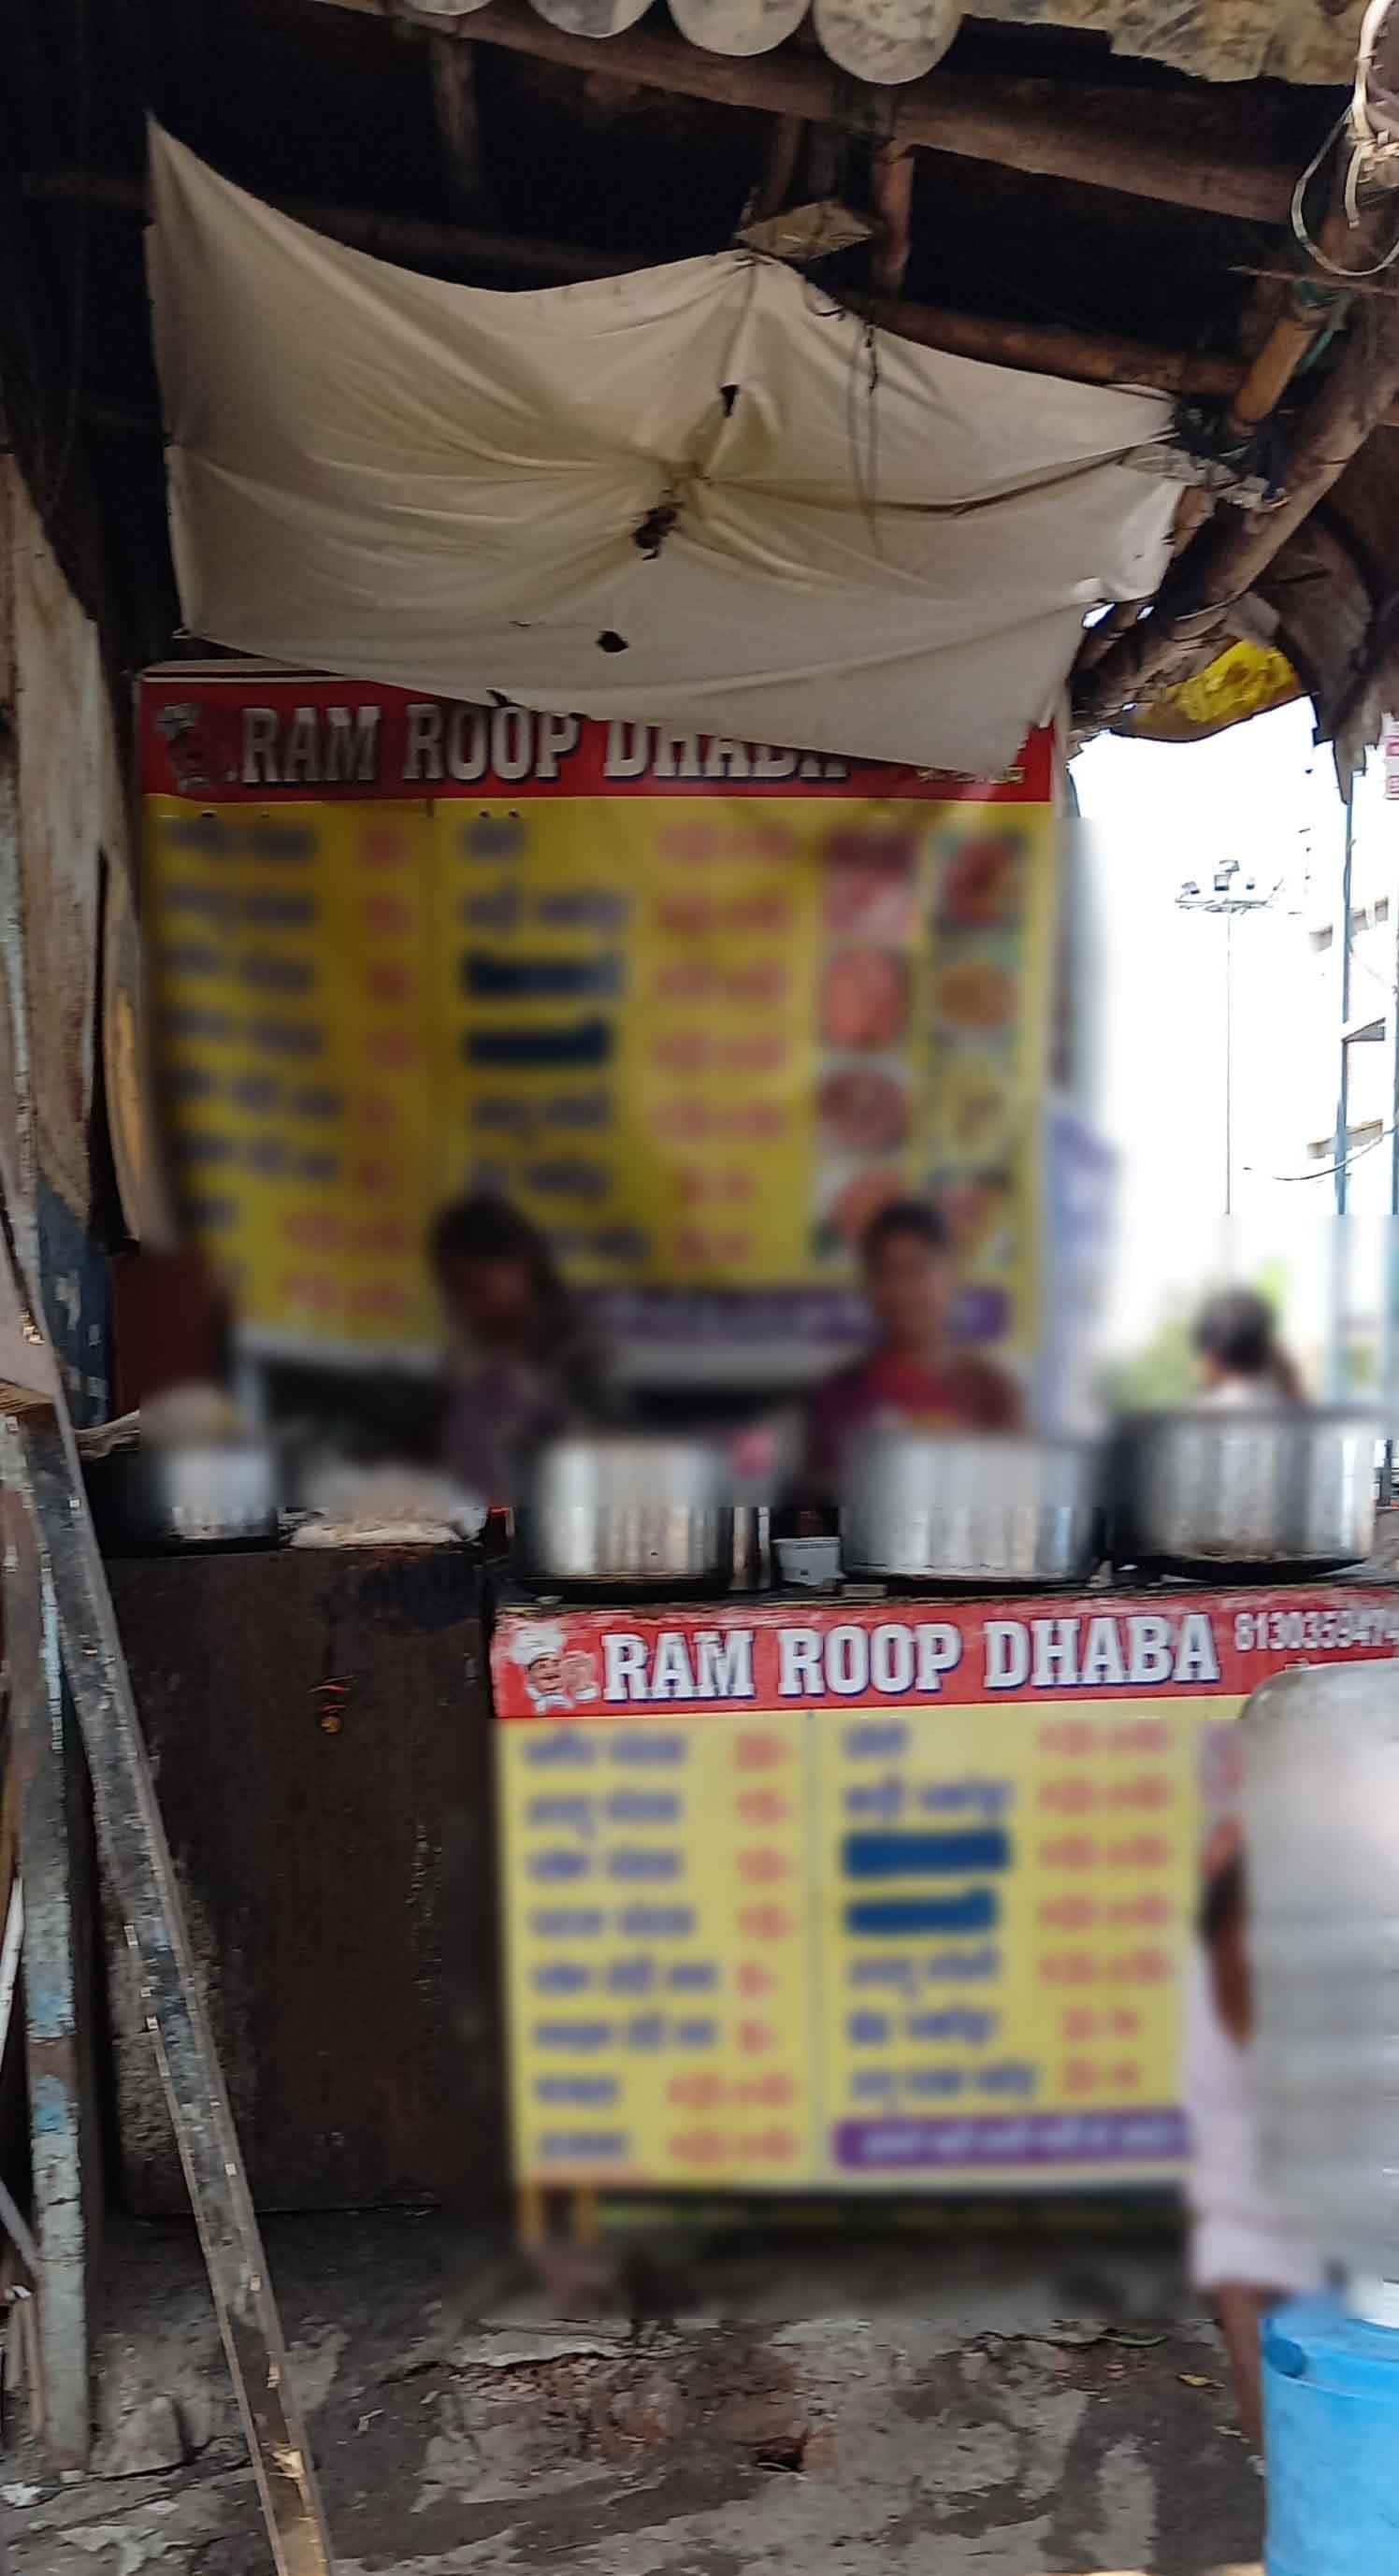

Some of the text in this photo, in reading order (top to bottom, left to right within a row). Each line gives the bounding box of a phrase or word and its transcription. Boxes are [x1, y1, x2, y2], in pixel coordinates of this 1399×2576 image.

[240, 706, 382, 783] RAM
[402, 703, 582, 780] ROOP
[601, 1632, 756, 1701] RAM
[777, 1622, 961, 1692] ROOP
[983, 1614, 1220, 1689] DHABA
